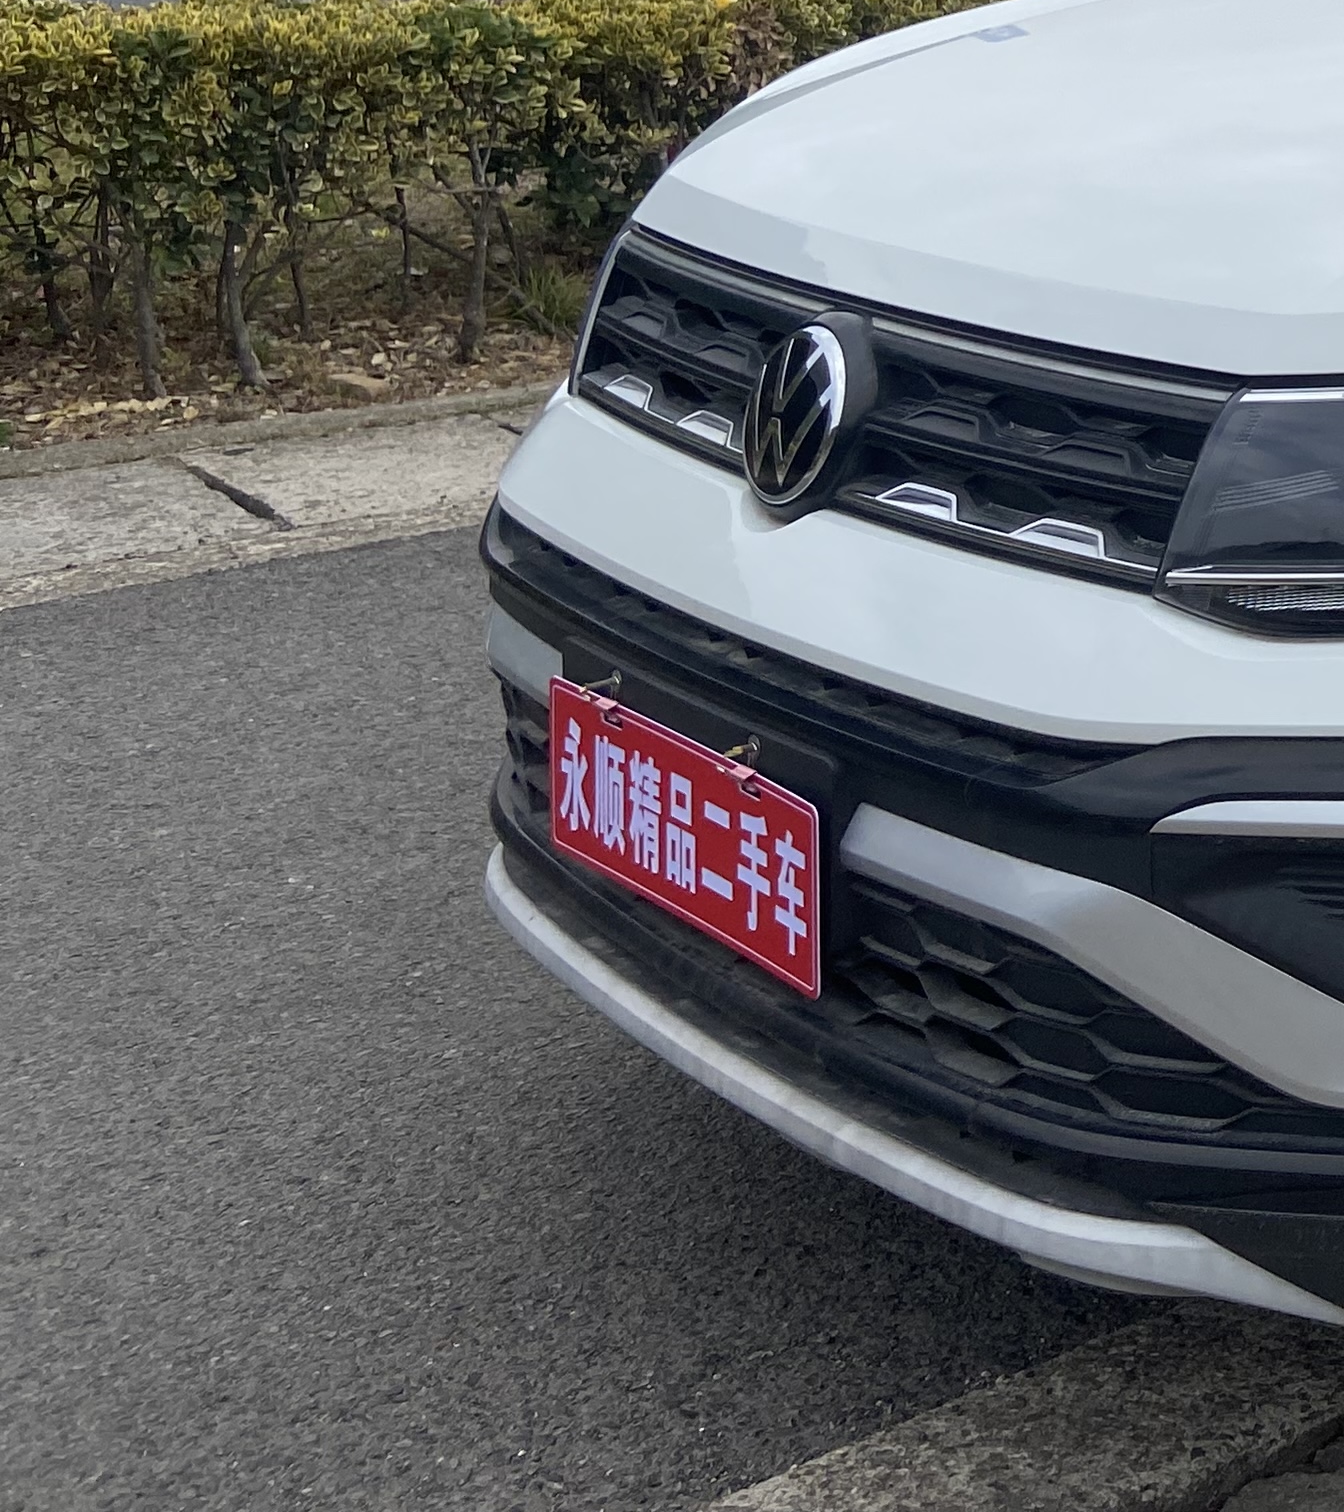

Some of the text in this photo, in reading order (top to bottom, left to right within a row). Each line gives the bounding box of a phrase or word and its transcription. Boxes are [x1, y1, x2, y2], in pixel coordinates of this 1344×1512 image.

[560, 717, 807, 956] 永顺精品二手车
